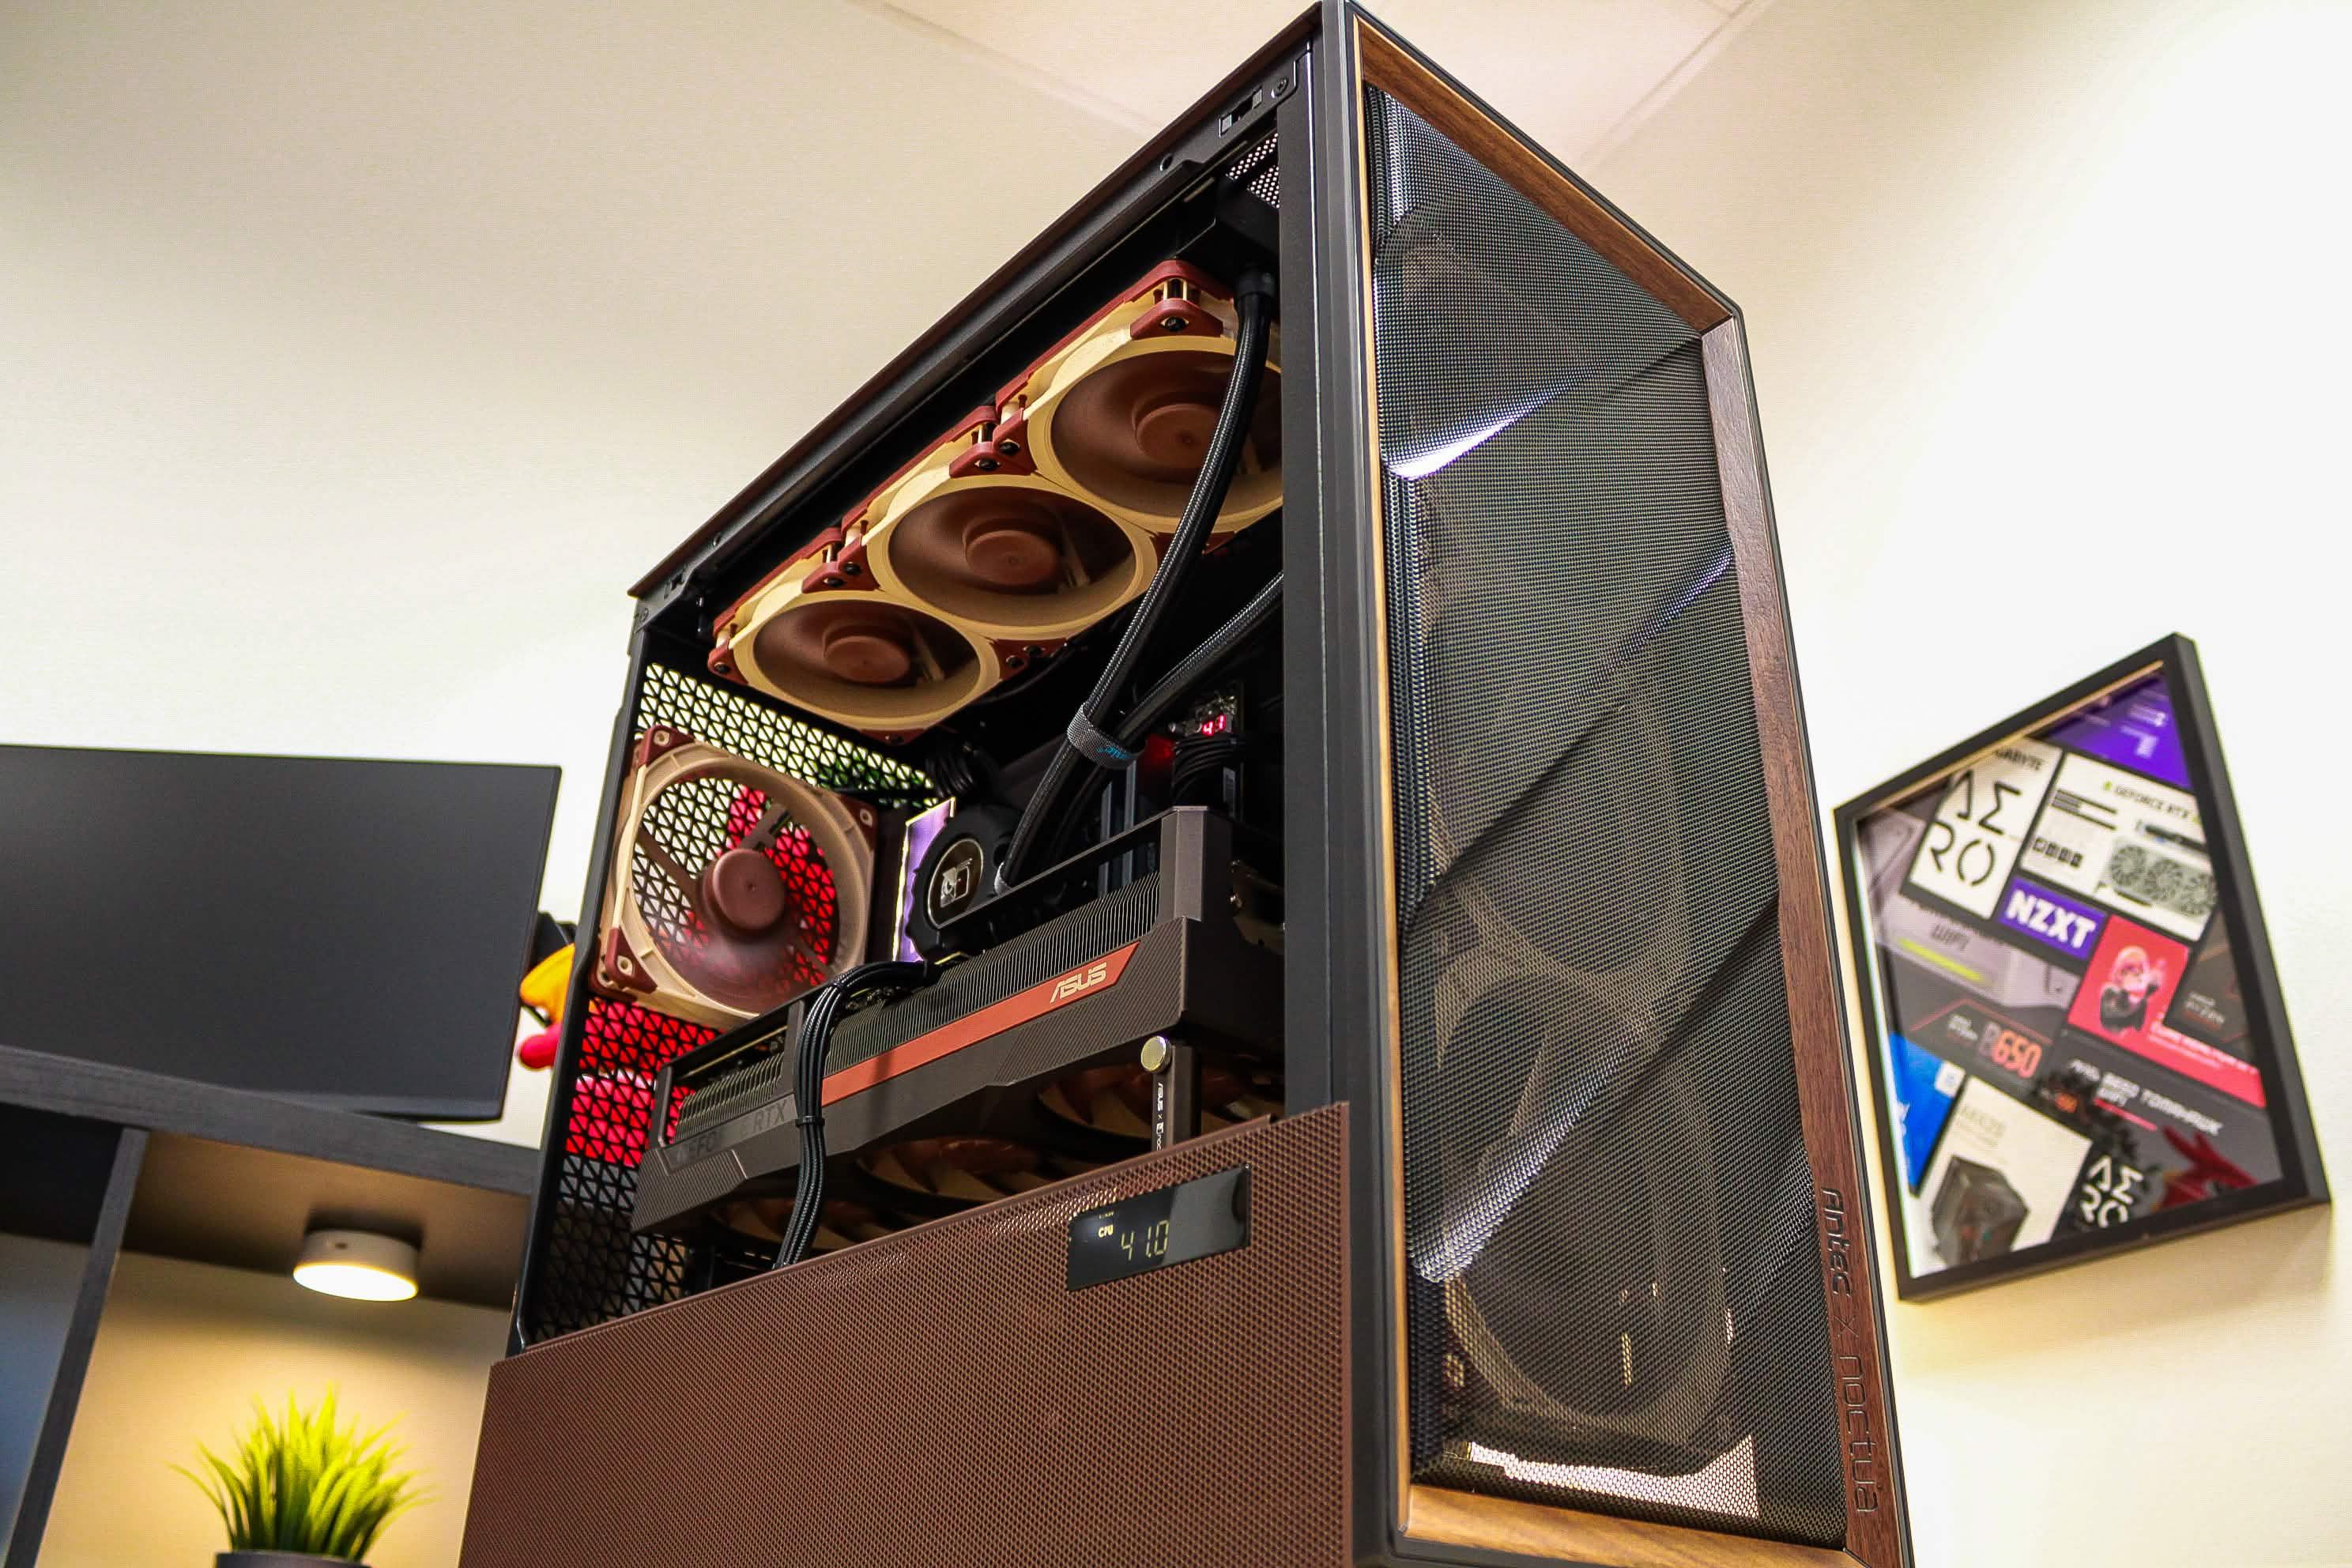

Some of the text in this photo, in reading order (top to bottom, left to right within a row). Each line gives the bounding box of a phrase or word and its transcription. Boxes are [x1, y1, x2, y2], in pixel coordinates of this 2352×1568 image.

[2006, 889, 2098, 949] NZXT
[1050, 961, 1108, 1004] ASUS
[1978, 1021, 2042, 1079] B650
[752, 1100, 788, 1133] RTX
[1098, 1224, 1114, 1238] CPU
[1838, 1353, 1880, 1513] noctua
